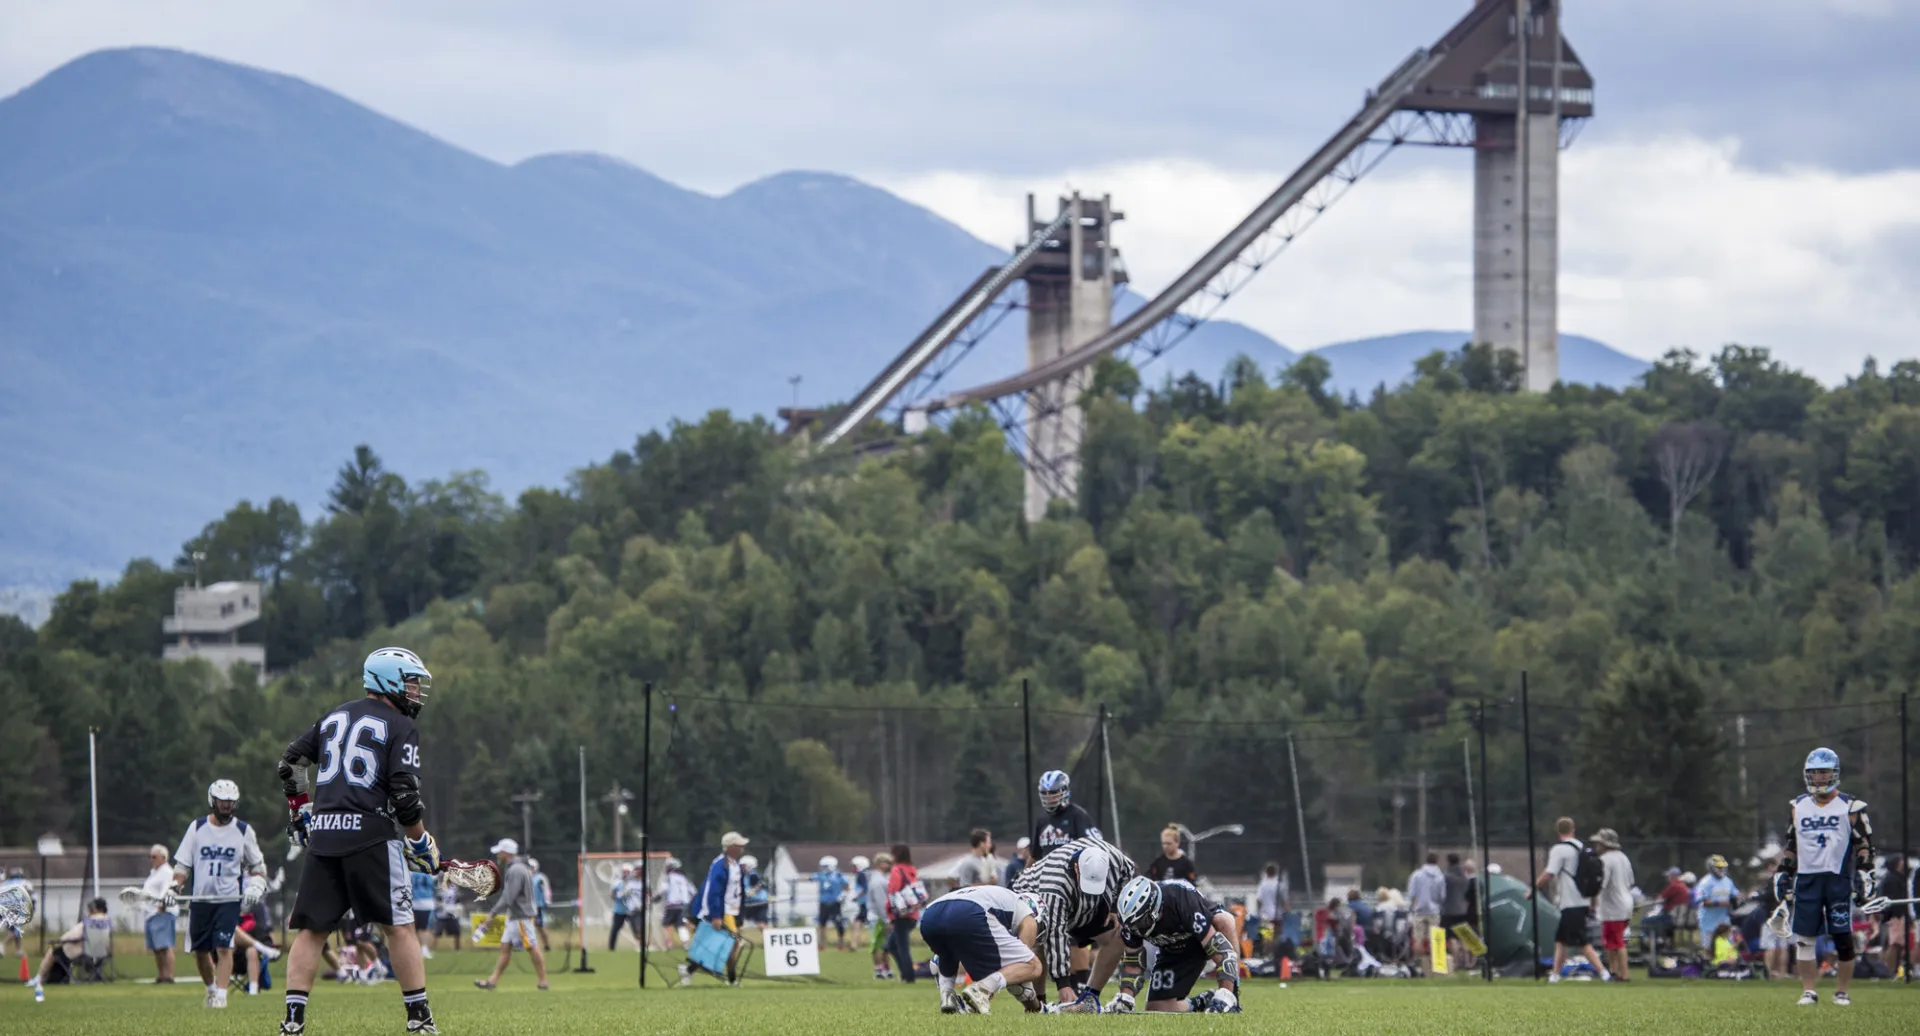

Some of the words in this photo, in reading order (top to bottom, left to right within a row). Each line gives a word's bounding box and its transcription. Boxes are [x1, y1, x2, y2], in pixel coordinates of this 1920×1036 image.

[316, 711, 388, 789] 36
[401, 743, 421, 768] 36
[310, 814, 362, 831] SAVAGE
[1817, 833, 1827, 848] 4
[208, 862, 222, 877] 11
[770, 933, 812, 947] FIELD
[786, 949, 799, 967] 6
[1151, 969, 1175, 990] 83
